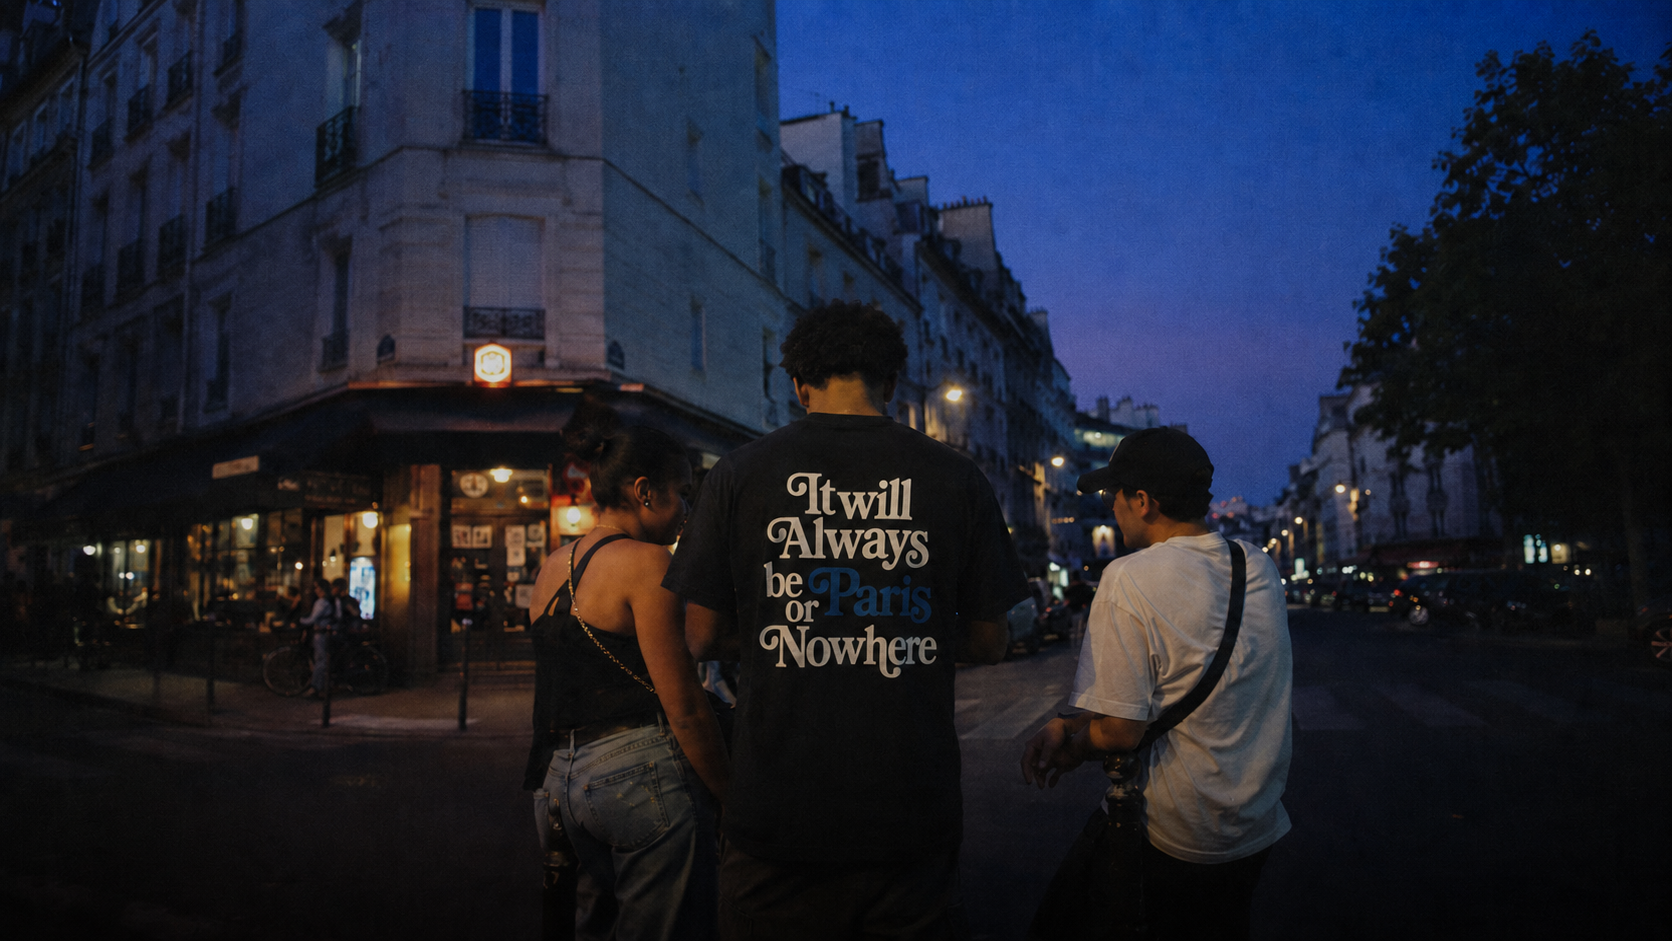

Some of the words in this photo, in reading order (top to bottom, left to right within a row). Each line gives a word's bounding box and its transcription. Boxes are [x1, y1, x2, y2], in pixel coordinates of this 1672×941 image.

[786, 472, 836, 516] It
[837, 477, 913, 520] will
[766, 516, 930, 571] Always
[763, 561, 803, 598] be
[808, 566, 932, 624] Paris
[785, 599, 820, 623] or
[759, 624, 938, 679] Nowhere
